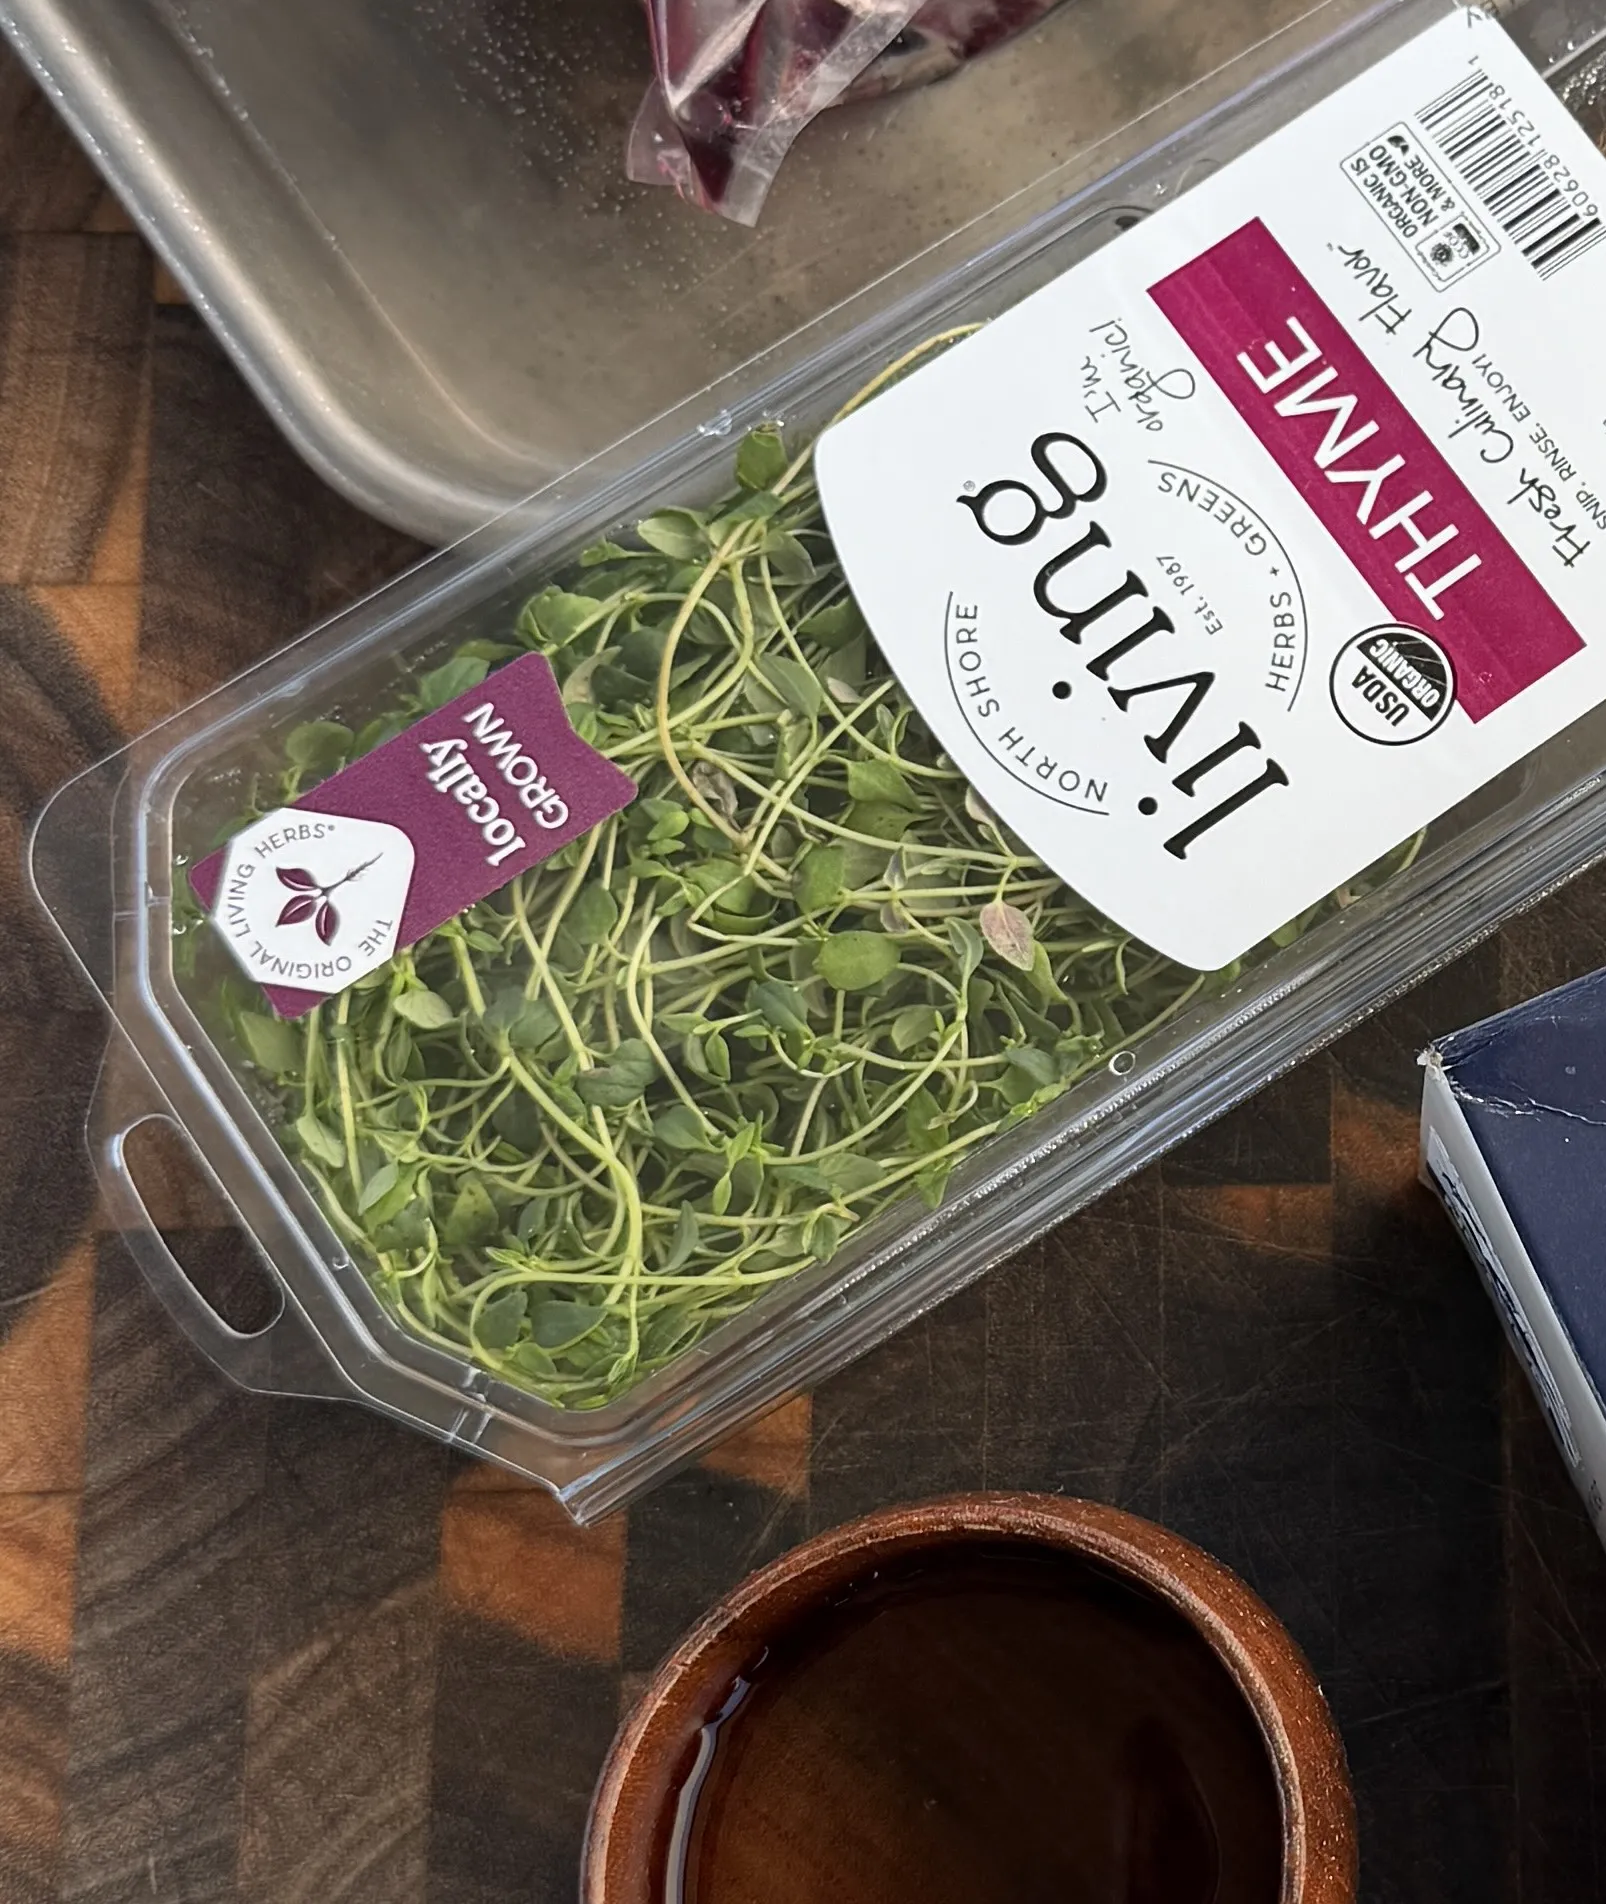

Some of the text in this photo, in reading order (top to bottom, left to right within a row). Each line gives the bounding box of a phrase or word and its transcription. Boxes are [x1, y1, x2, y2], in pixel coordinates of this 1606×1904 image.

[1485, 81, 1544, 150] 12518
[1350, 156, 1418, 237] ORGANIC IS
[1368, 144, 1438, 226] NON-GMO
[1403, 154, 1455, 211] & MORE
[1540, 150, 1601, 222] 60628
[1441, 226, 1473, 262] CCOF
[1088, 319, 1195, 431] organic!
[1412, 306, 1513, 463] Culinary
[1471, 352, 1531, 422] ENJOY!
[1236, 315, 1481, 619] THYME
[1528, 422, 1576, 481] RINSE.
[1157, 471, 1266, 555] GREENS
[1506, 467, 1590, 567] Fresh
[1155, 555, 1223, 634] Est. 1987
[956, 431, 1289, 859] living
[1264, 591, 1291, 691] HERBS
[1369, 638, 1440, 708] ORGANIC
[955, 604, 1107, 801] NORTH SHORE
[1351, 664, 1409, 726] USDA
[420, 738, 525, 866] locally
[463, 702, 568, 828] GROWN
[227, 822, 393, 978] THE ORIGINAL LIVING HERBS
